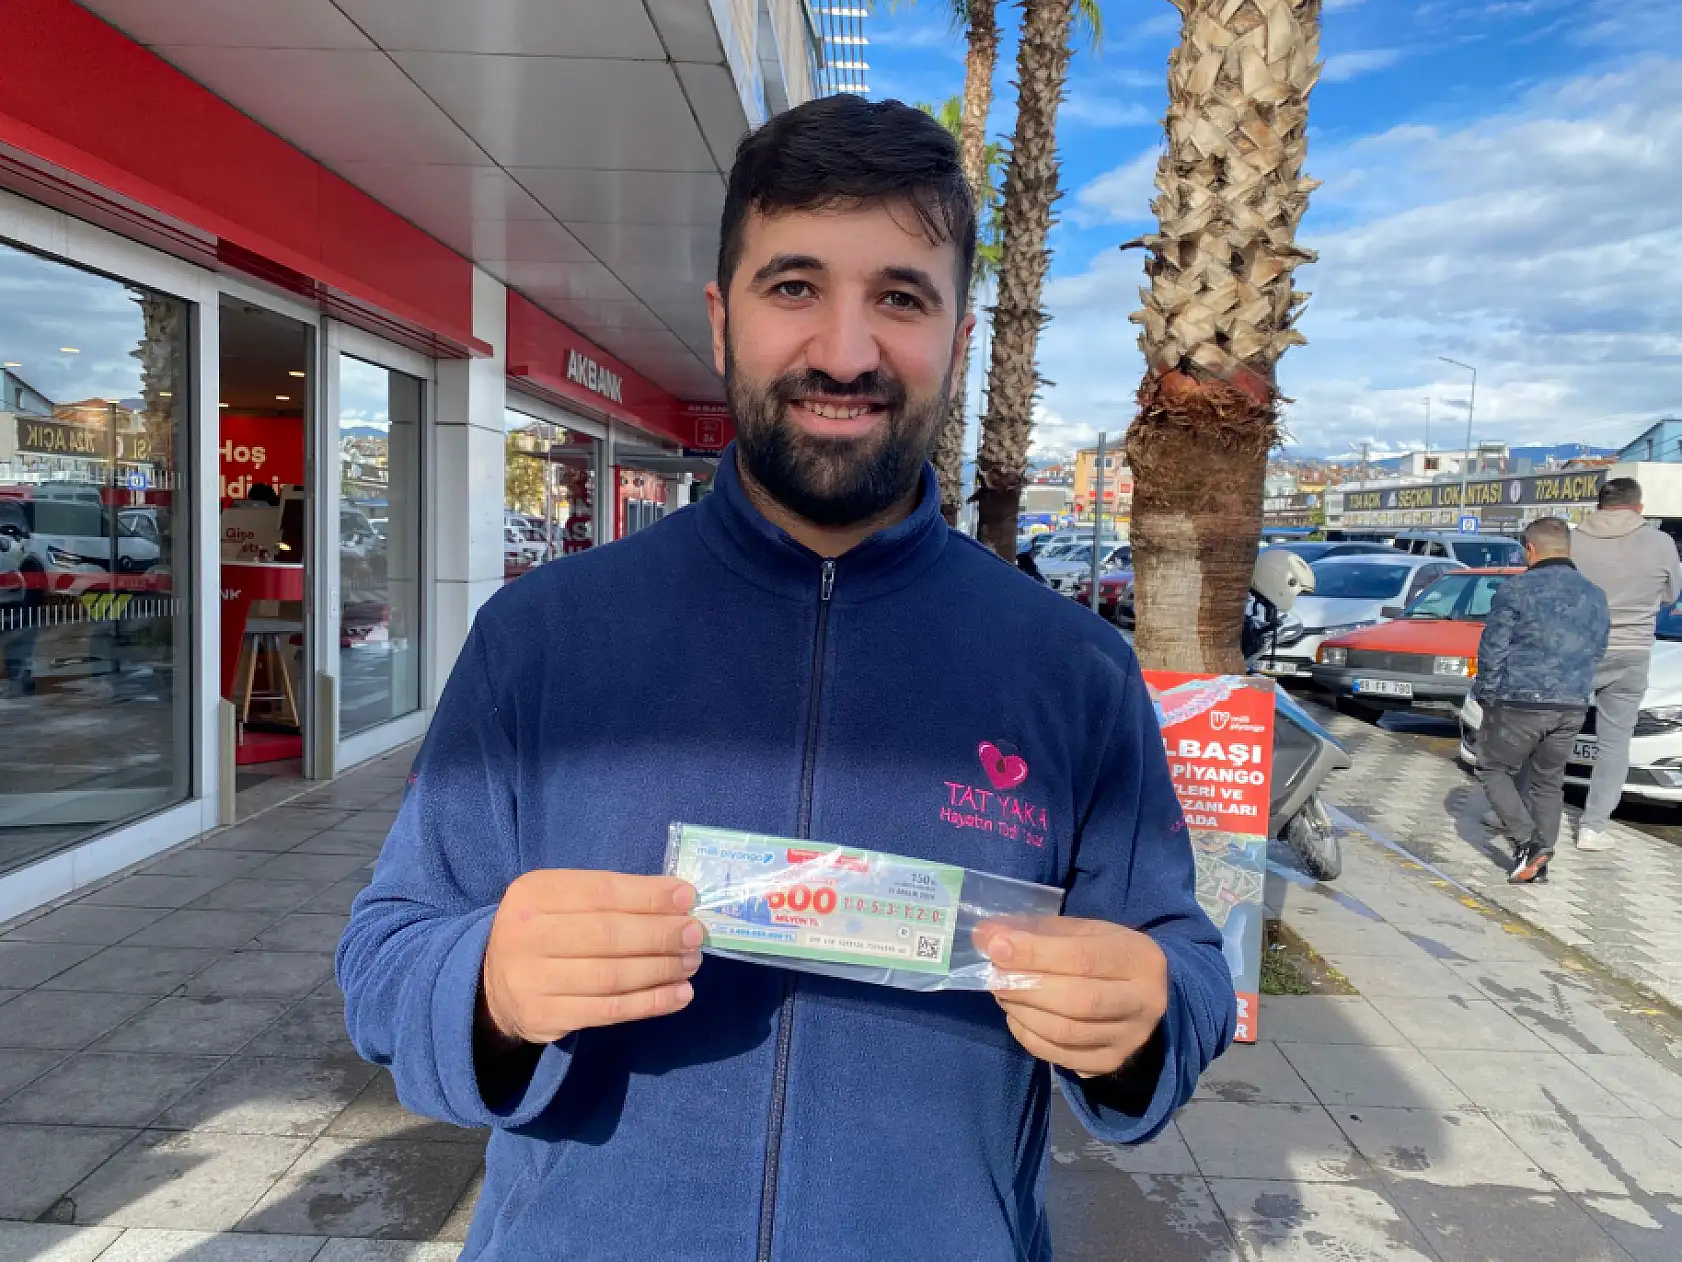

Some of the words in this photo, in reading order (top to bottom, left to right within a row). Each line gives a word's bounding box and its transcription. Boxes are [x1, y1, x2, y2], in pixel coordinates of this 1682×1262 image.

[566, 348, 623, 405] AKBANK
[1438, 482, 1503, 505] LOKNTASI
[1561, 474, 1599, 503] AÇIK
[1172, 762, 1265, 785] PİYANGO
[943, 780, 995, 812] TAT
[997, 795, 1048, 831] YAKA
[1219, 787, 1245, 800] VE
